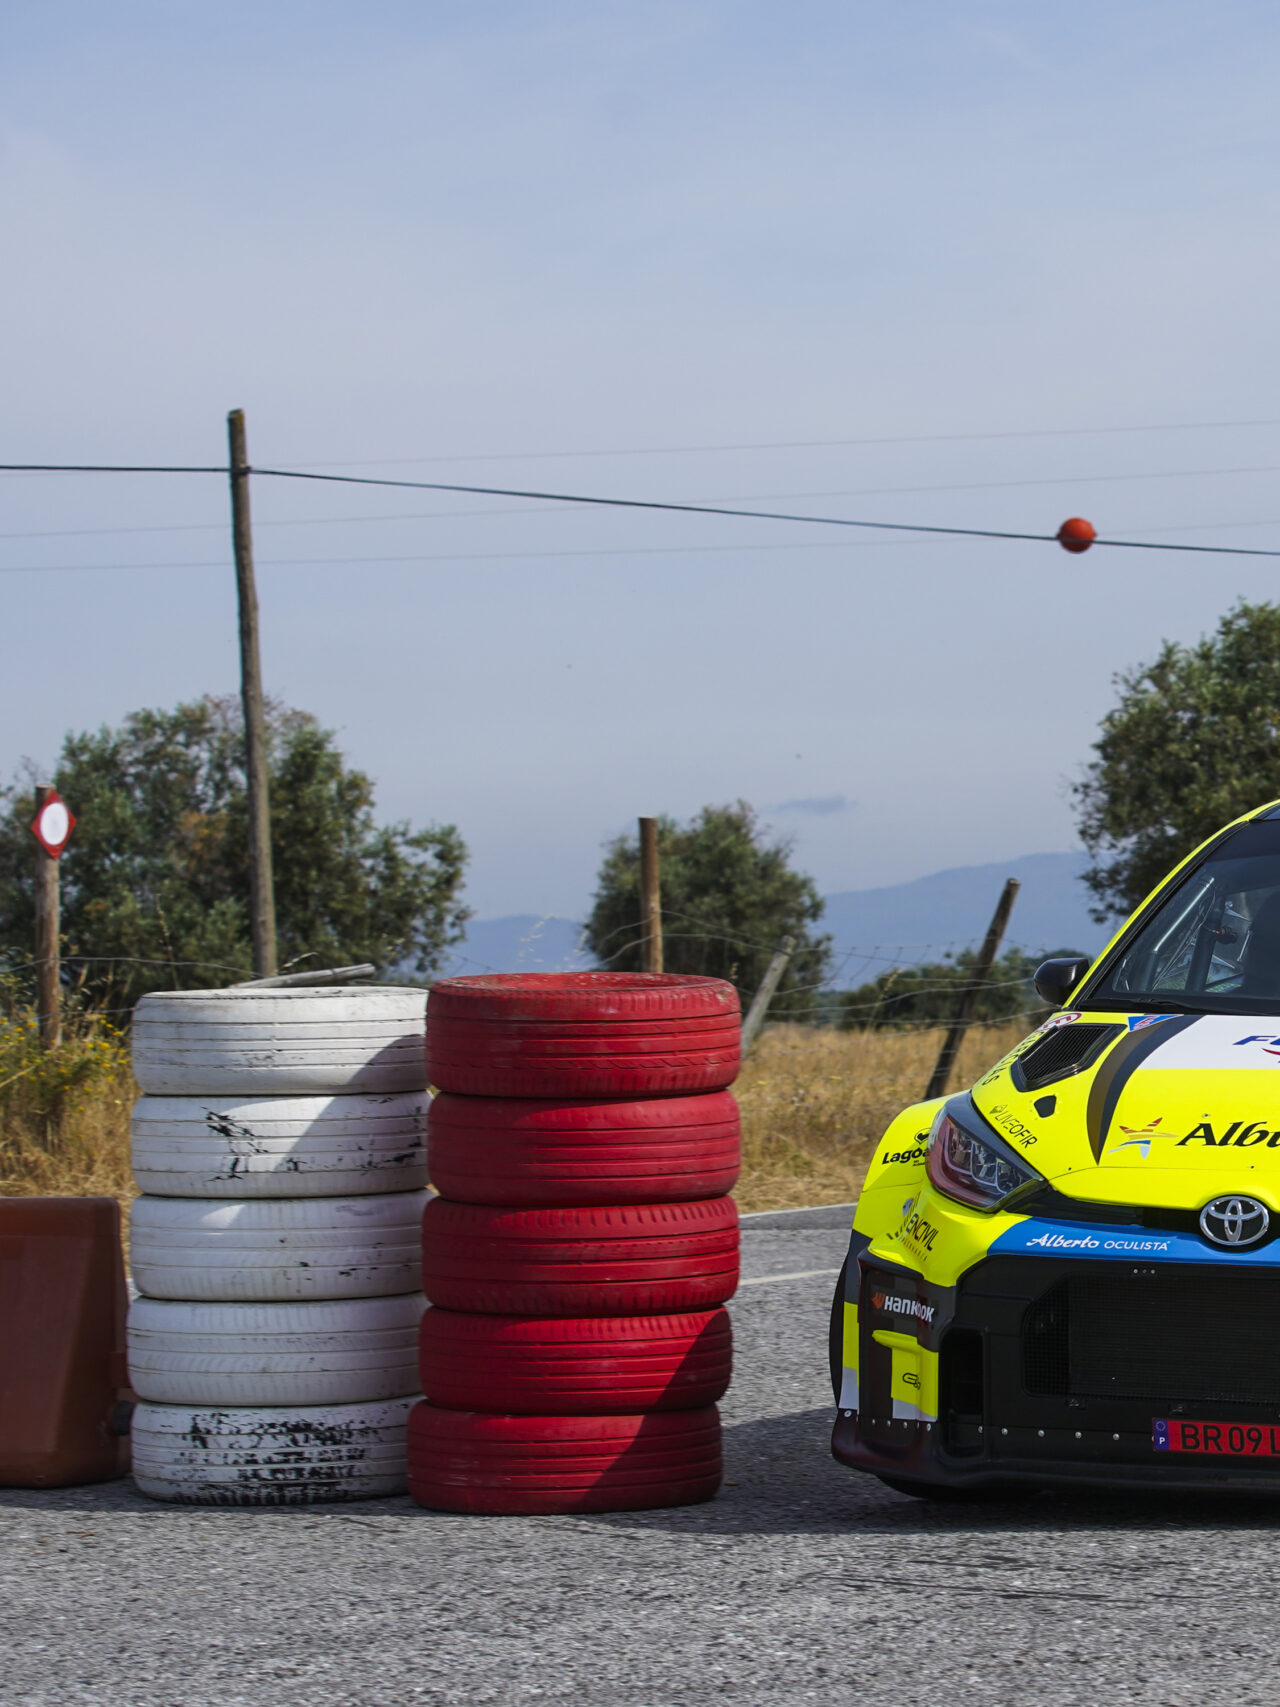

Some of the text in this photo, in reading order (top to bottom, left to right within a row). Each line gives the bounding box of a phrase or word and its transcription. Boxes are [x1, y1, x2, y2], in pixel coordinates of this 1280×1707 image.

[994, 1106, 1038, 1149] LIVEOFIR
[1026, 1233, 1168, 1251] Alberto OCULISTA
[1159, 1436, 1166, 1445] P
[1180, 1423, 1223, 1452] BR
[1227, 1426, 1263, 1453] 09
